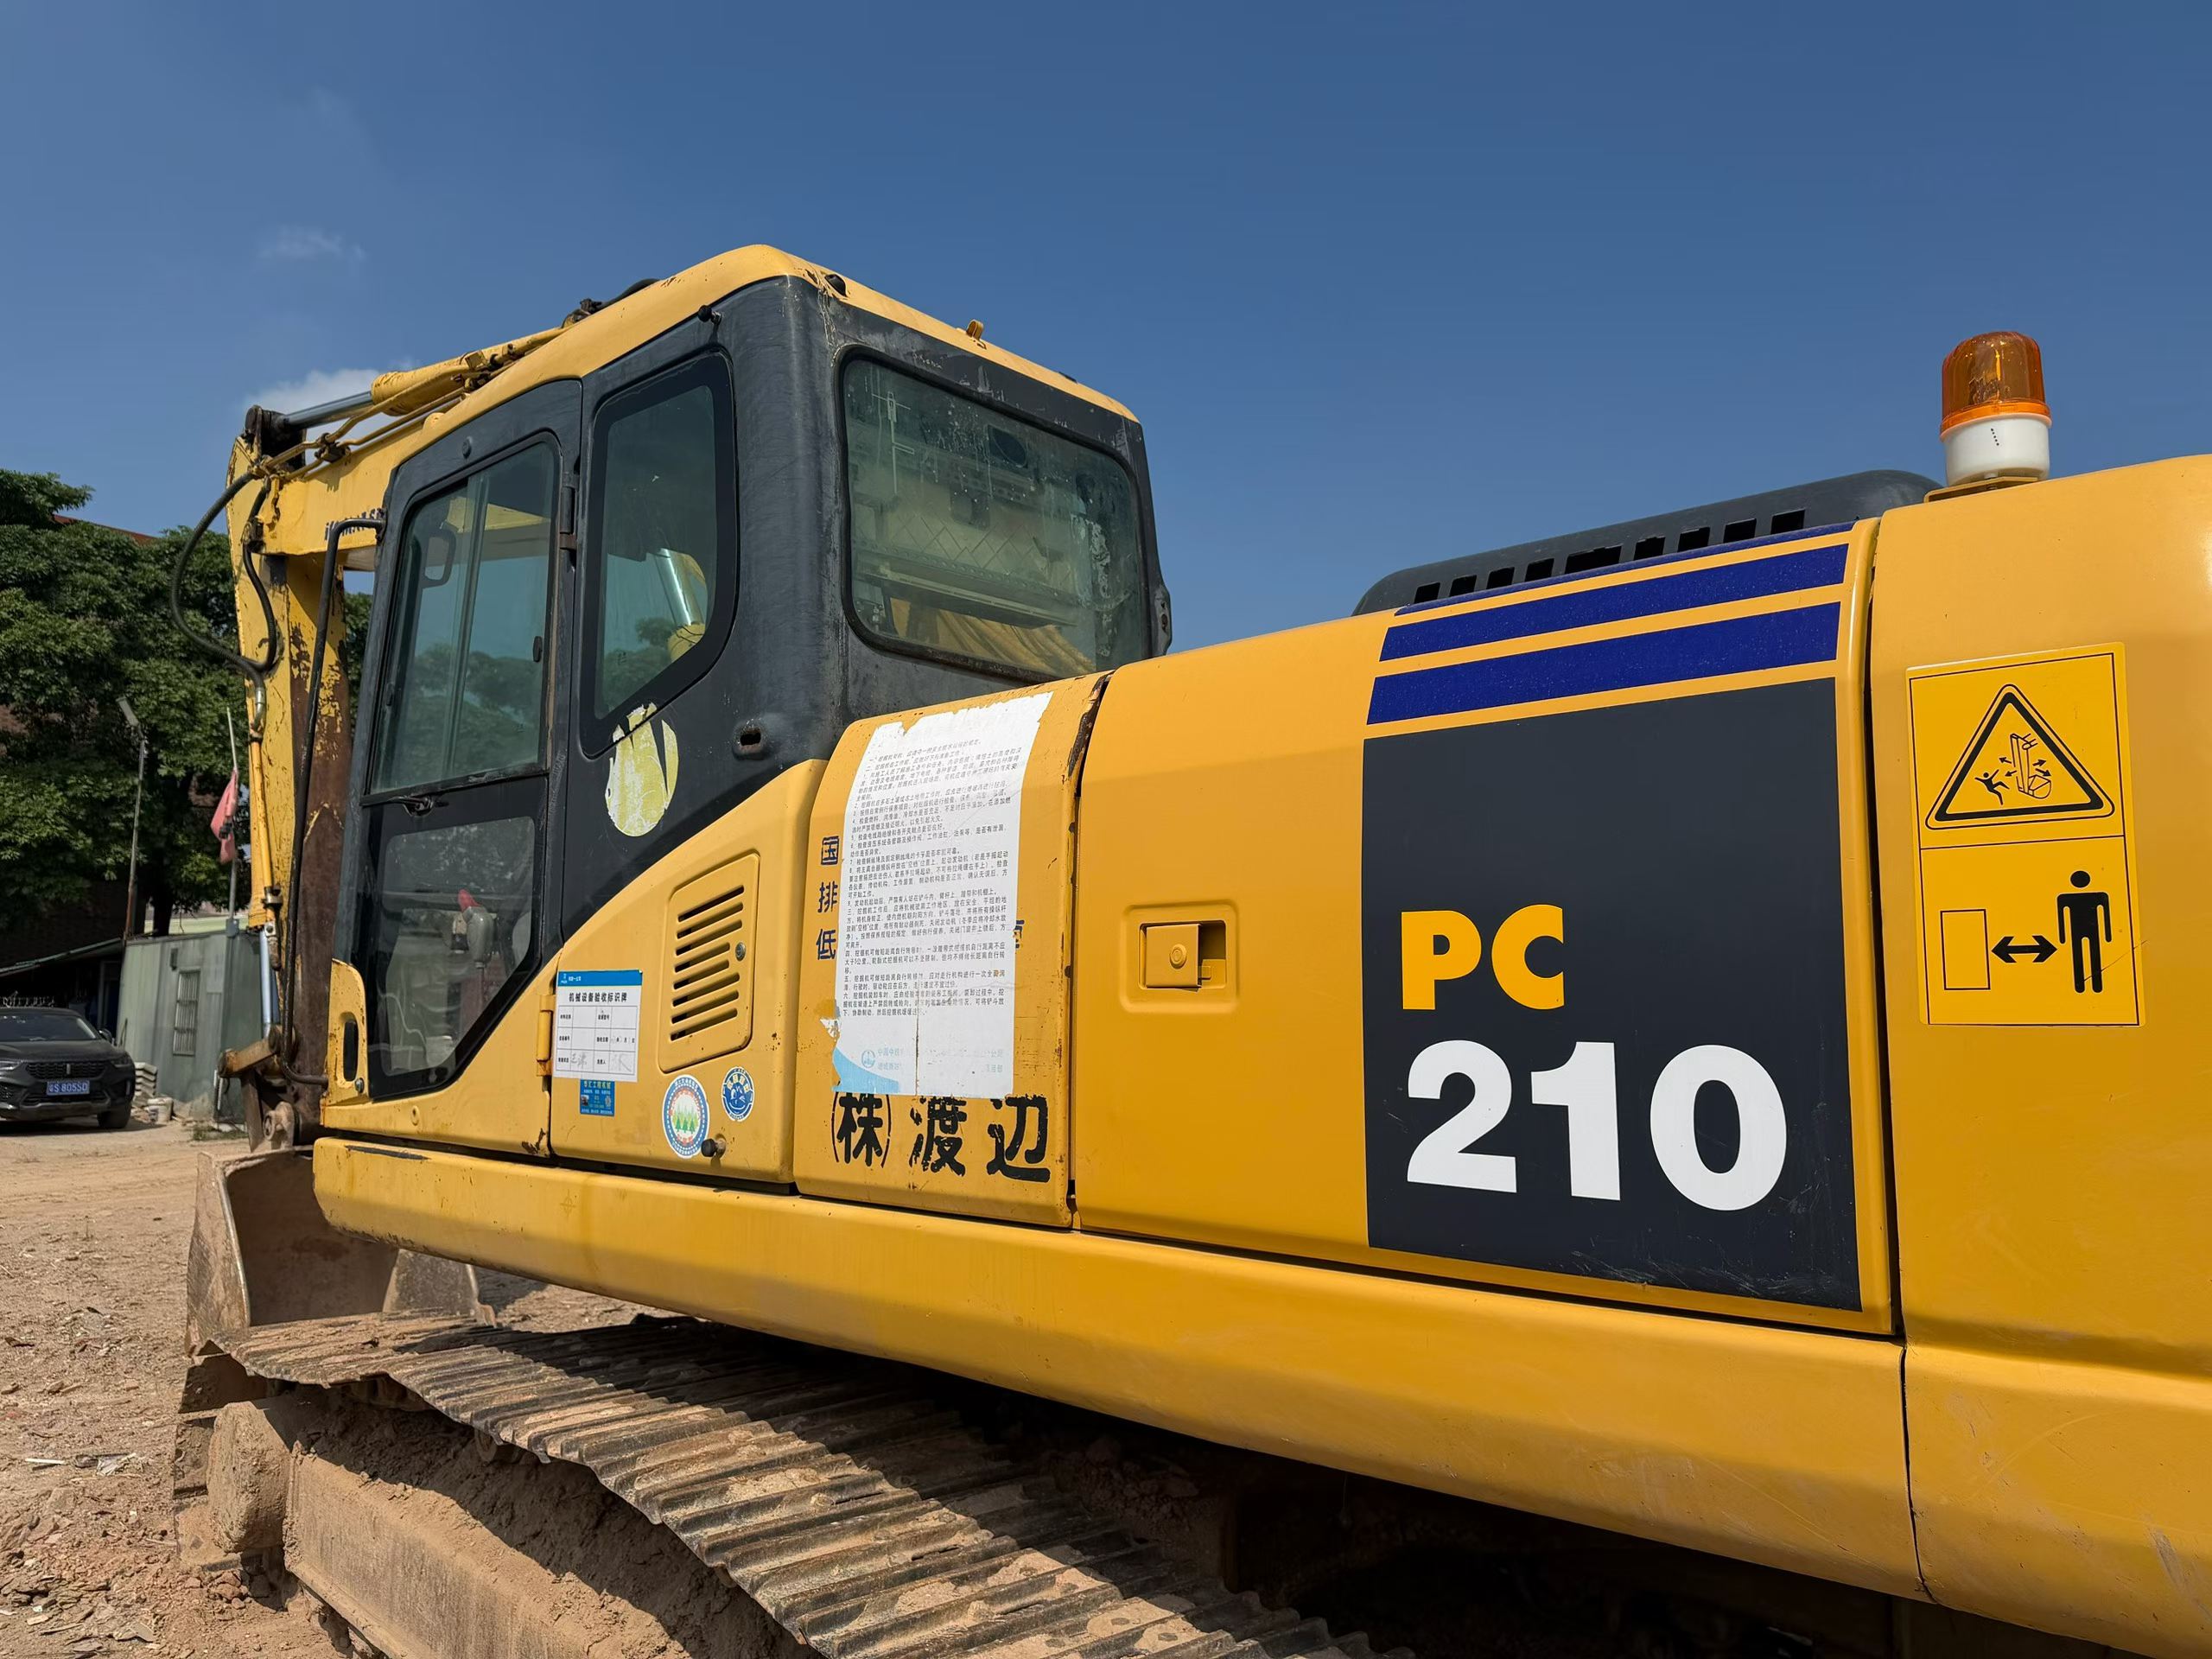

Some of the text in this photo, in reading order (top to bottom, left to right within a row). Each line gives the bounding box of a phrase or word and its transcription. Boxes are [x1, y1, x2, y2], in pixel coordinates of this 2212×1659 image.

[569, 992, 627, 1003] 机械设备验收标识牌
[1401, 904, 1565, 1010] PC
[1407, 1039, 1788, 1211] 210
